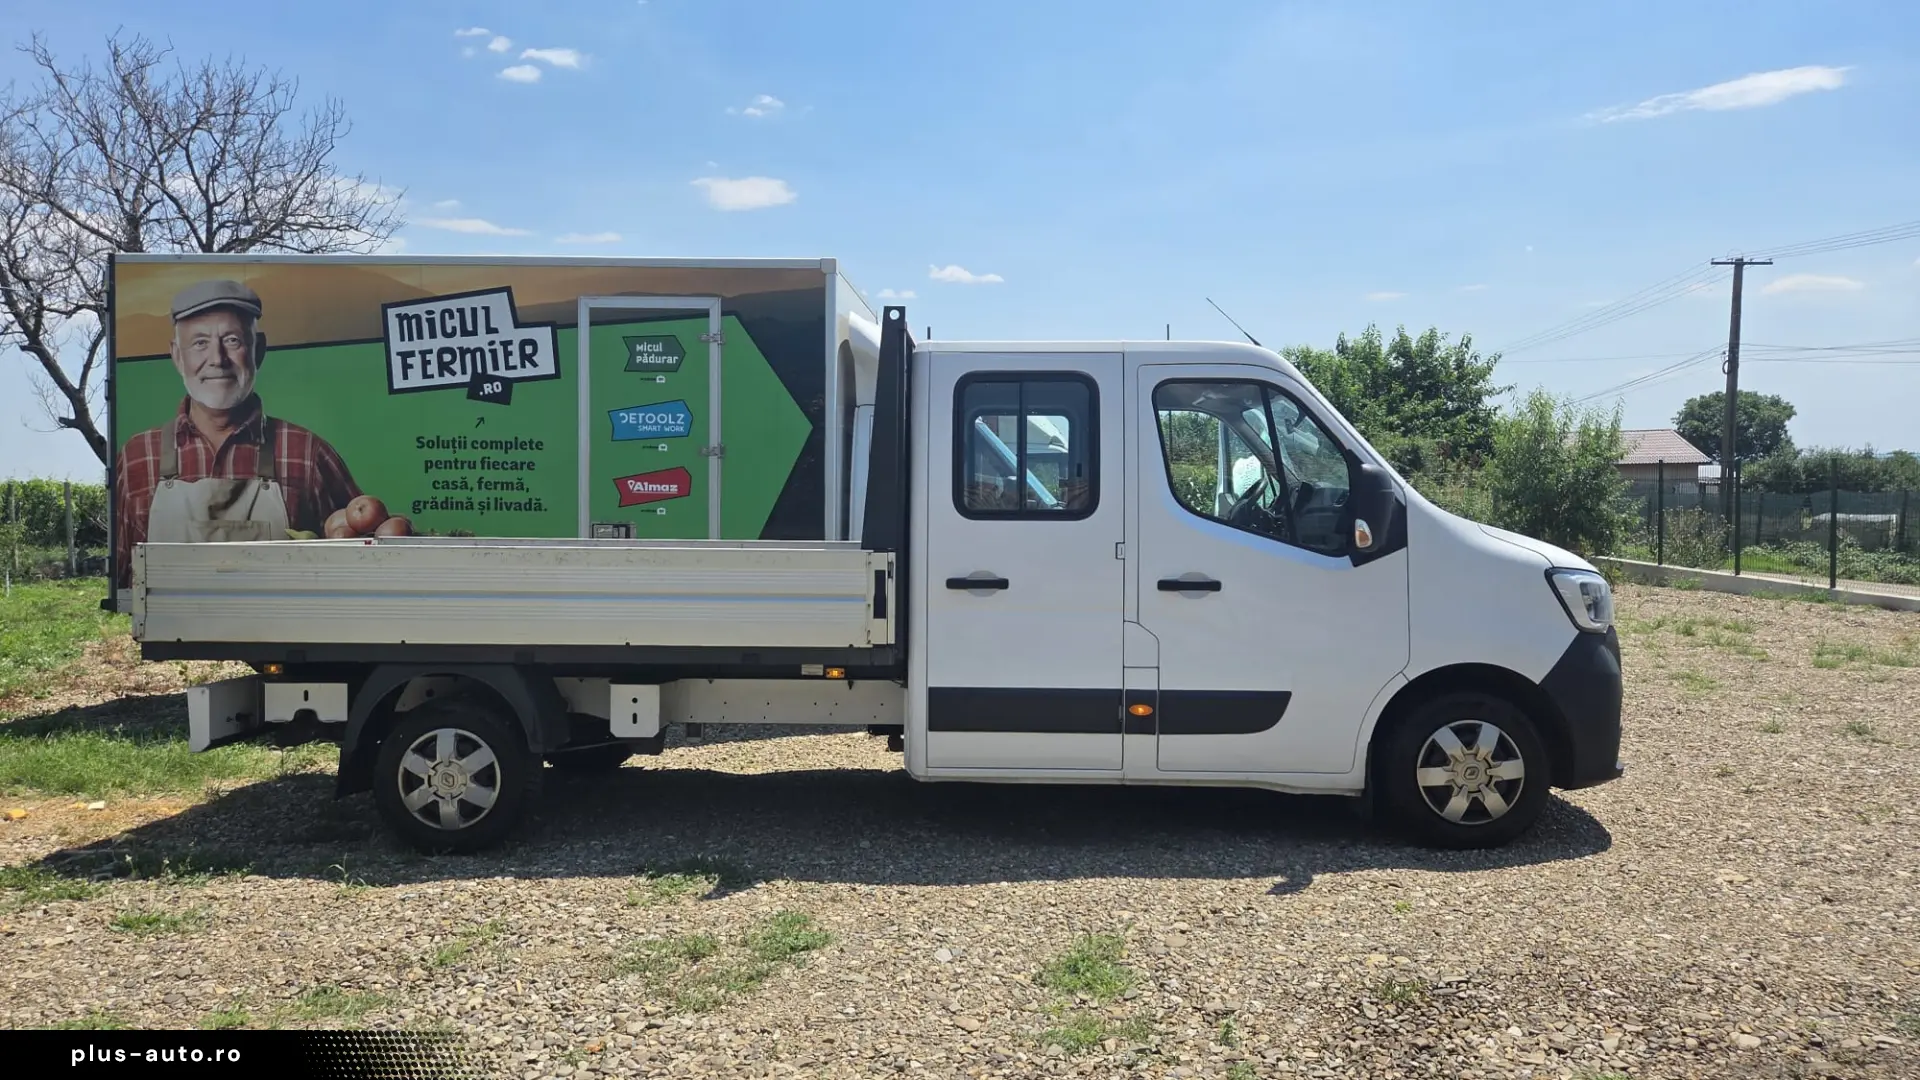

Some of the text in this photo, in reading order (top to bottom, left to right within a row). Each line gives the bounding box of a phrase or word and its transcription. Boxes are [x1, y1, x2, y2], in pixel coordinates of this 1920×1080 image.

[479, 381, 502, 395] .RO
[415, 435, 544, 454] Soluții complete
[424, 456, 536, 474] pentru fiecare
[432, 476, 530, 493] casă, fermă,
[411, 496, 548, 516] grădină și livadă.
